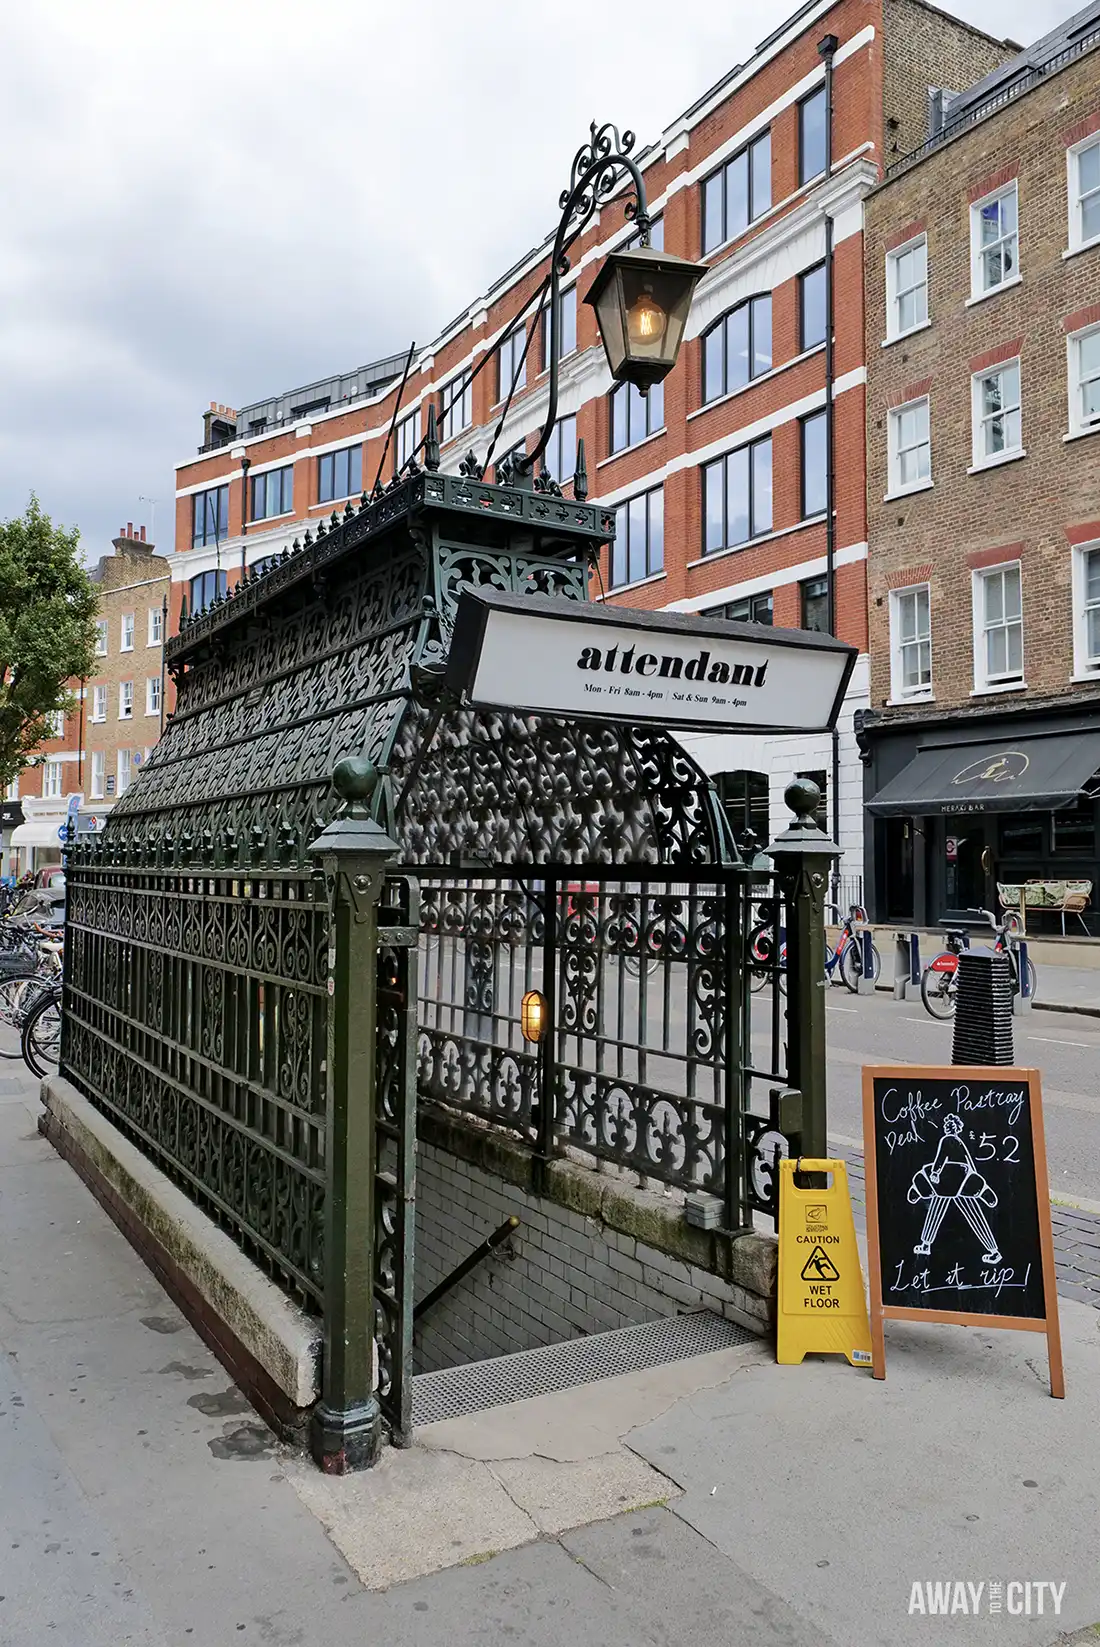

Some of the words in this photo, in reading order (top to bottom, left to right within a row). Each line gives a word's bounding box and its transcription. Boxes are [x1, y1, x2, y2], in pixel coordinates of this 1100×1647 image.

[576, 642, 769, 687] attendant
[584, 683, 601, 693] Mon
[608, 686, 620, 695] Fri
[624, 687, 640, 697] 8am
[646, 690, 663, 699] 4pm
[672, 692, 684, 701] Sat
[686, 694, 693, 702] &
[694, 694, 708, 703] Sun
[711, 696, 726, 705] 9am
[732, 698, 747, 707] 4pm
[881, 1088, 942, 1123] Coffee
[796, 1235, 840, 1244] CAUTION
[890, 1260, 931, 1291] Let
[945, 1262, 965, 1287] it
[809, 1286, 832, 1295] WET
[804, 1298, 840, 1308] FLOOR
